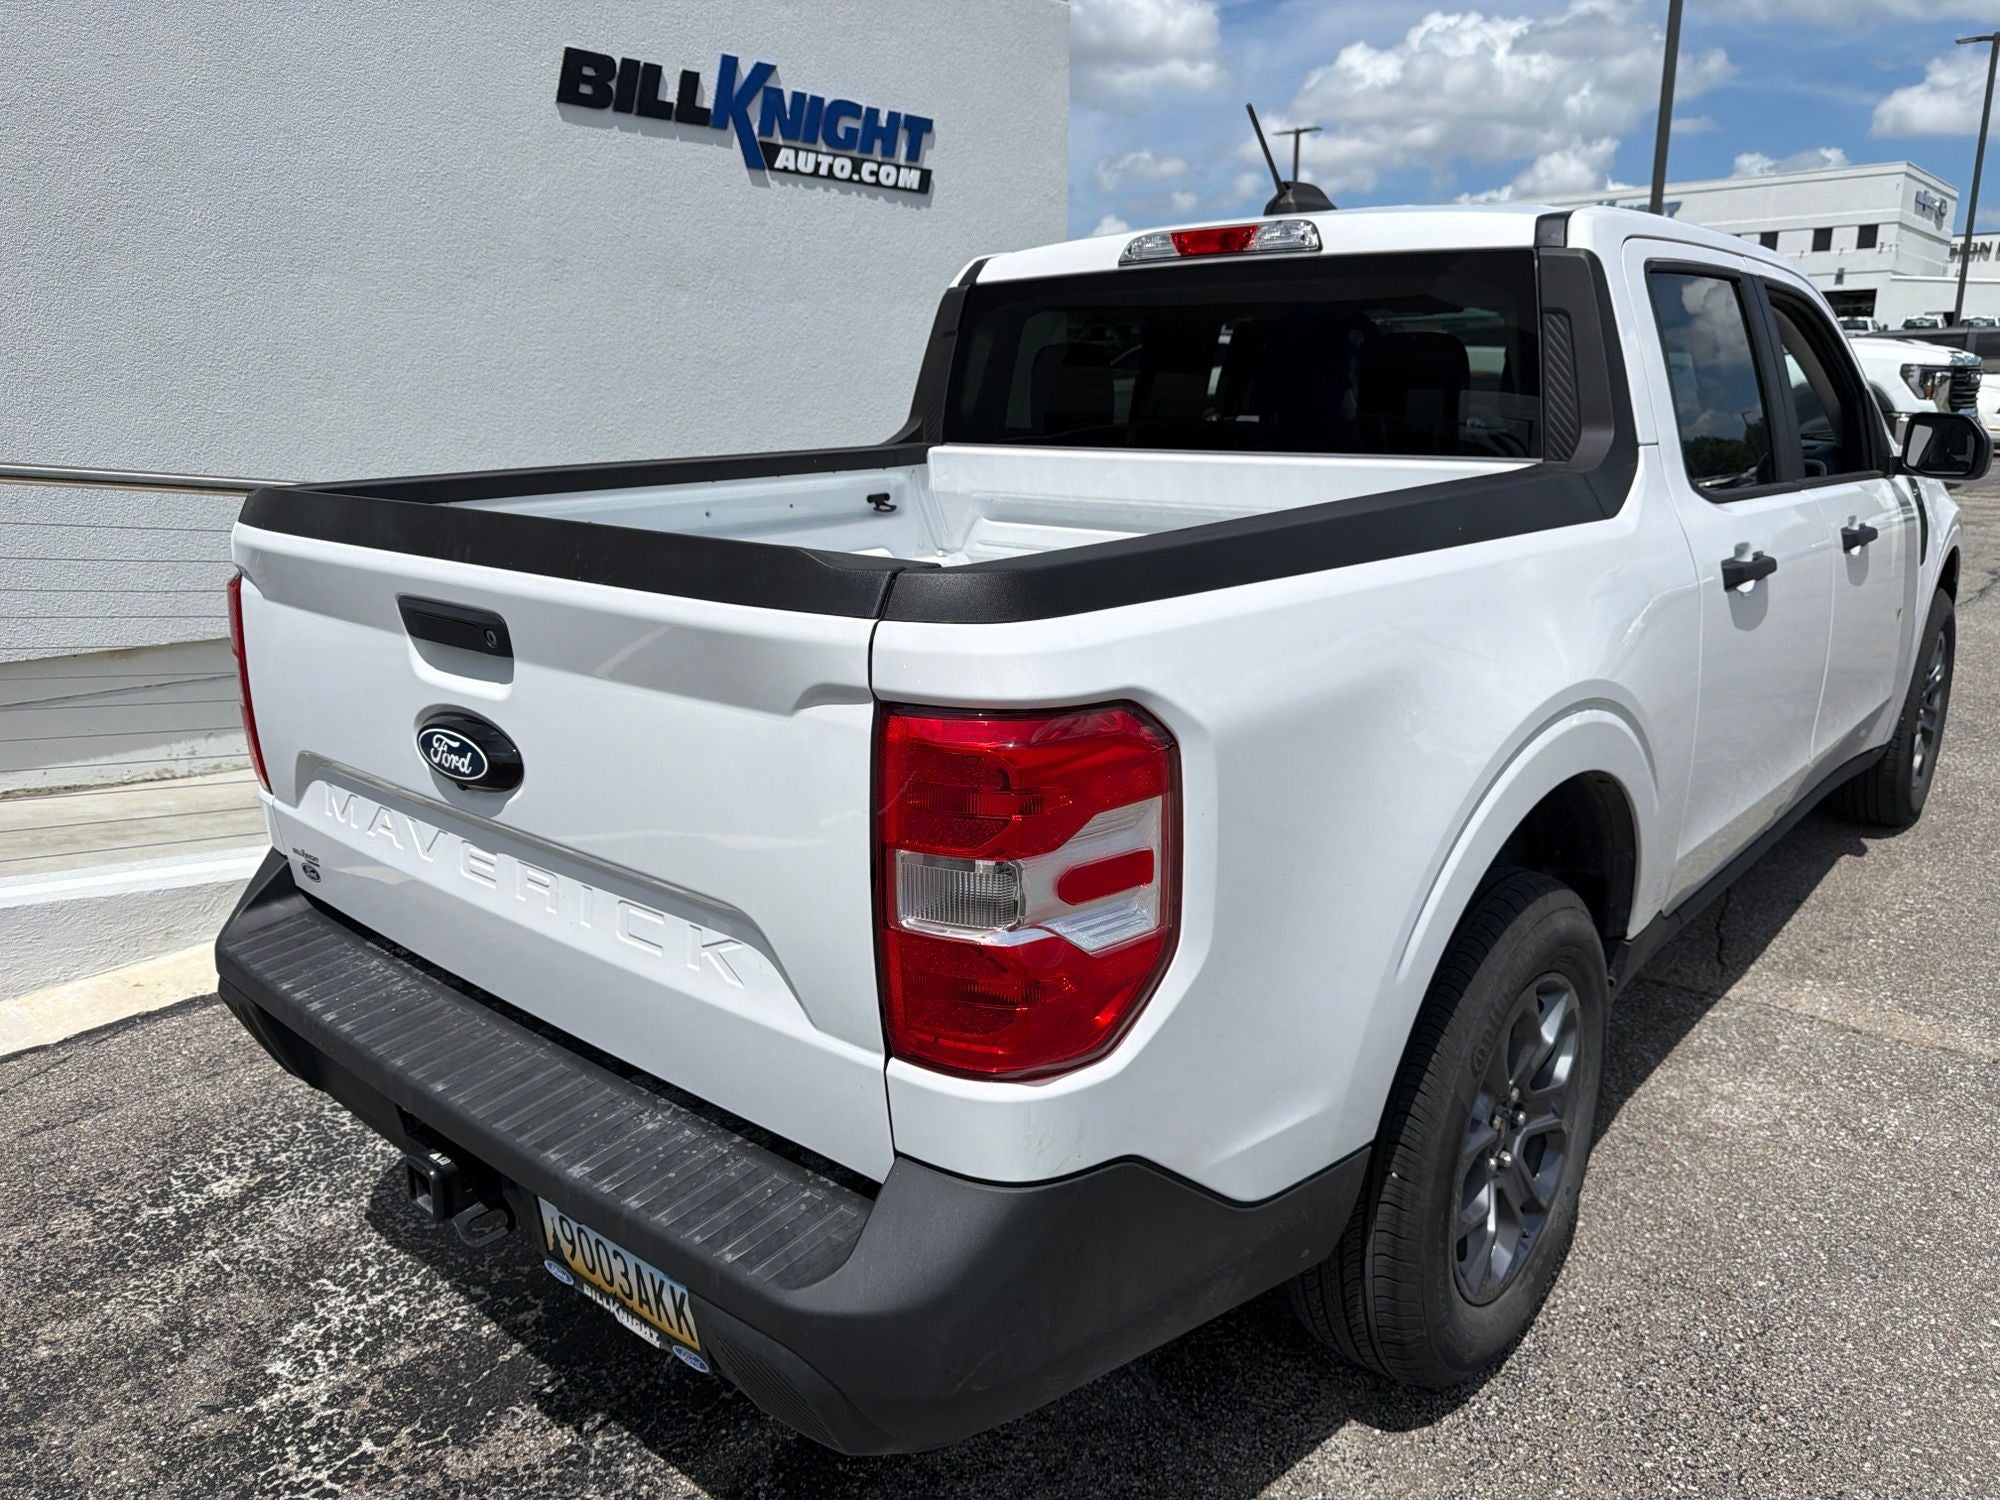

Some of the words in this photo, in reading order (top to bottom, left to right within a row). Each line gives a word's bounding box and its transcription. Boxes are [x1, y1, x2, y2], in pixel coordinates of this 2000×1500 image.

[774, 147, 921, 191] AUTO.COM
[430, 733, 472, 775] Ford
[324, 782, 745, 989] MAVERICK
[558, 1214, 697, 1343] 9003AKK
